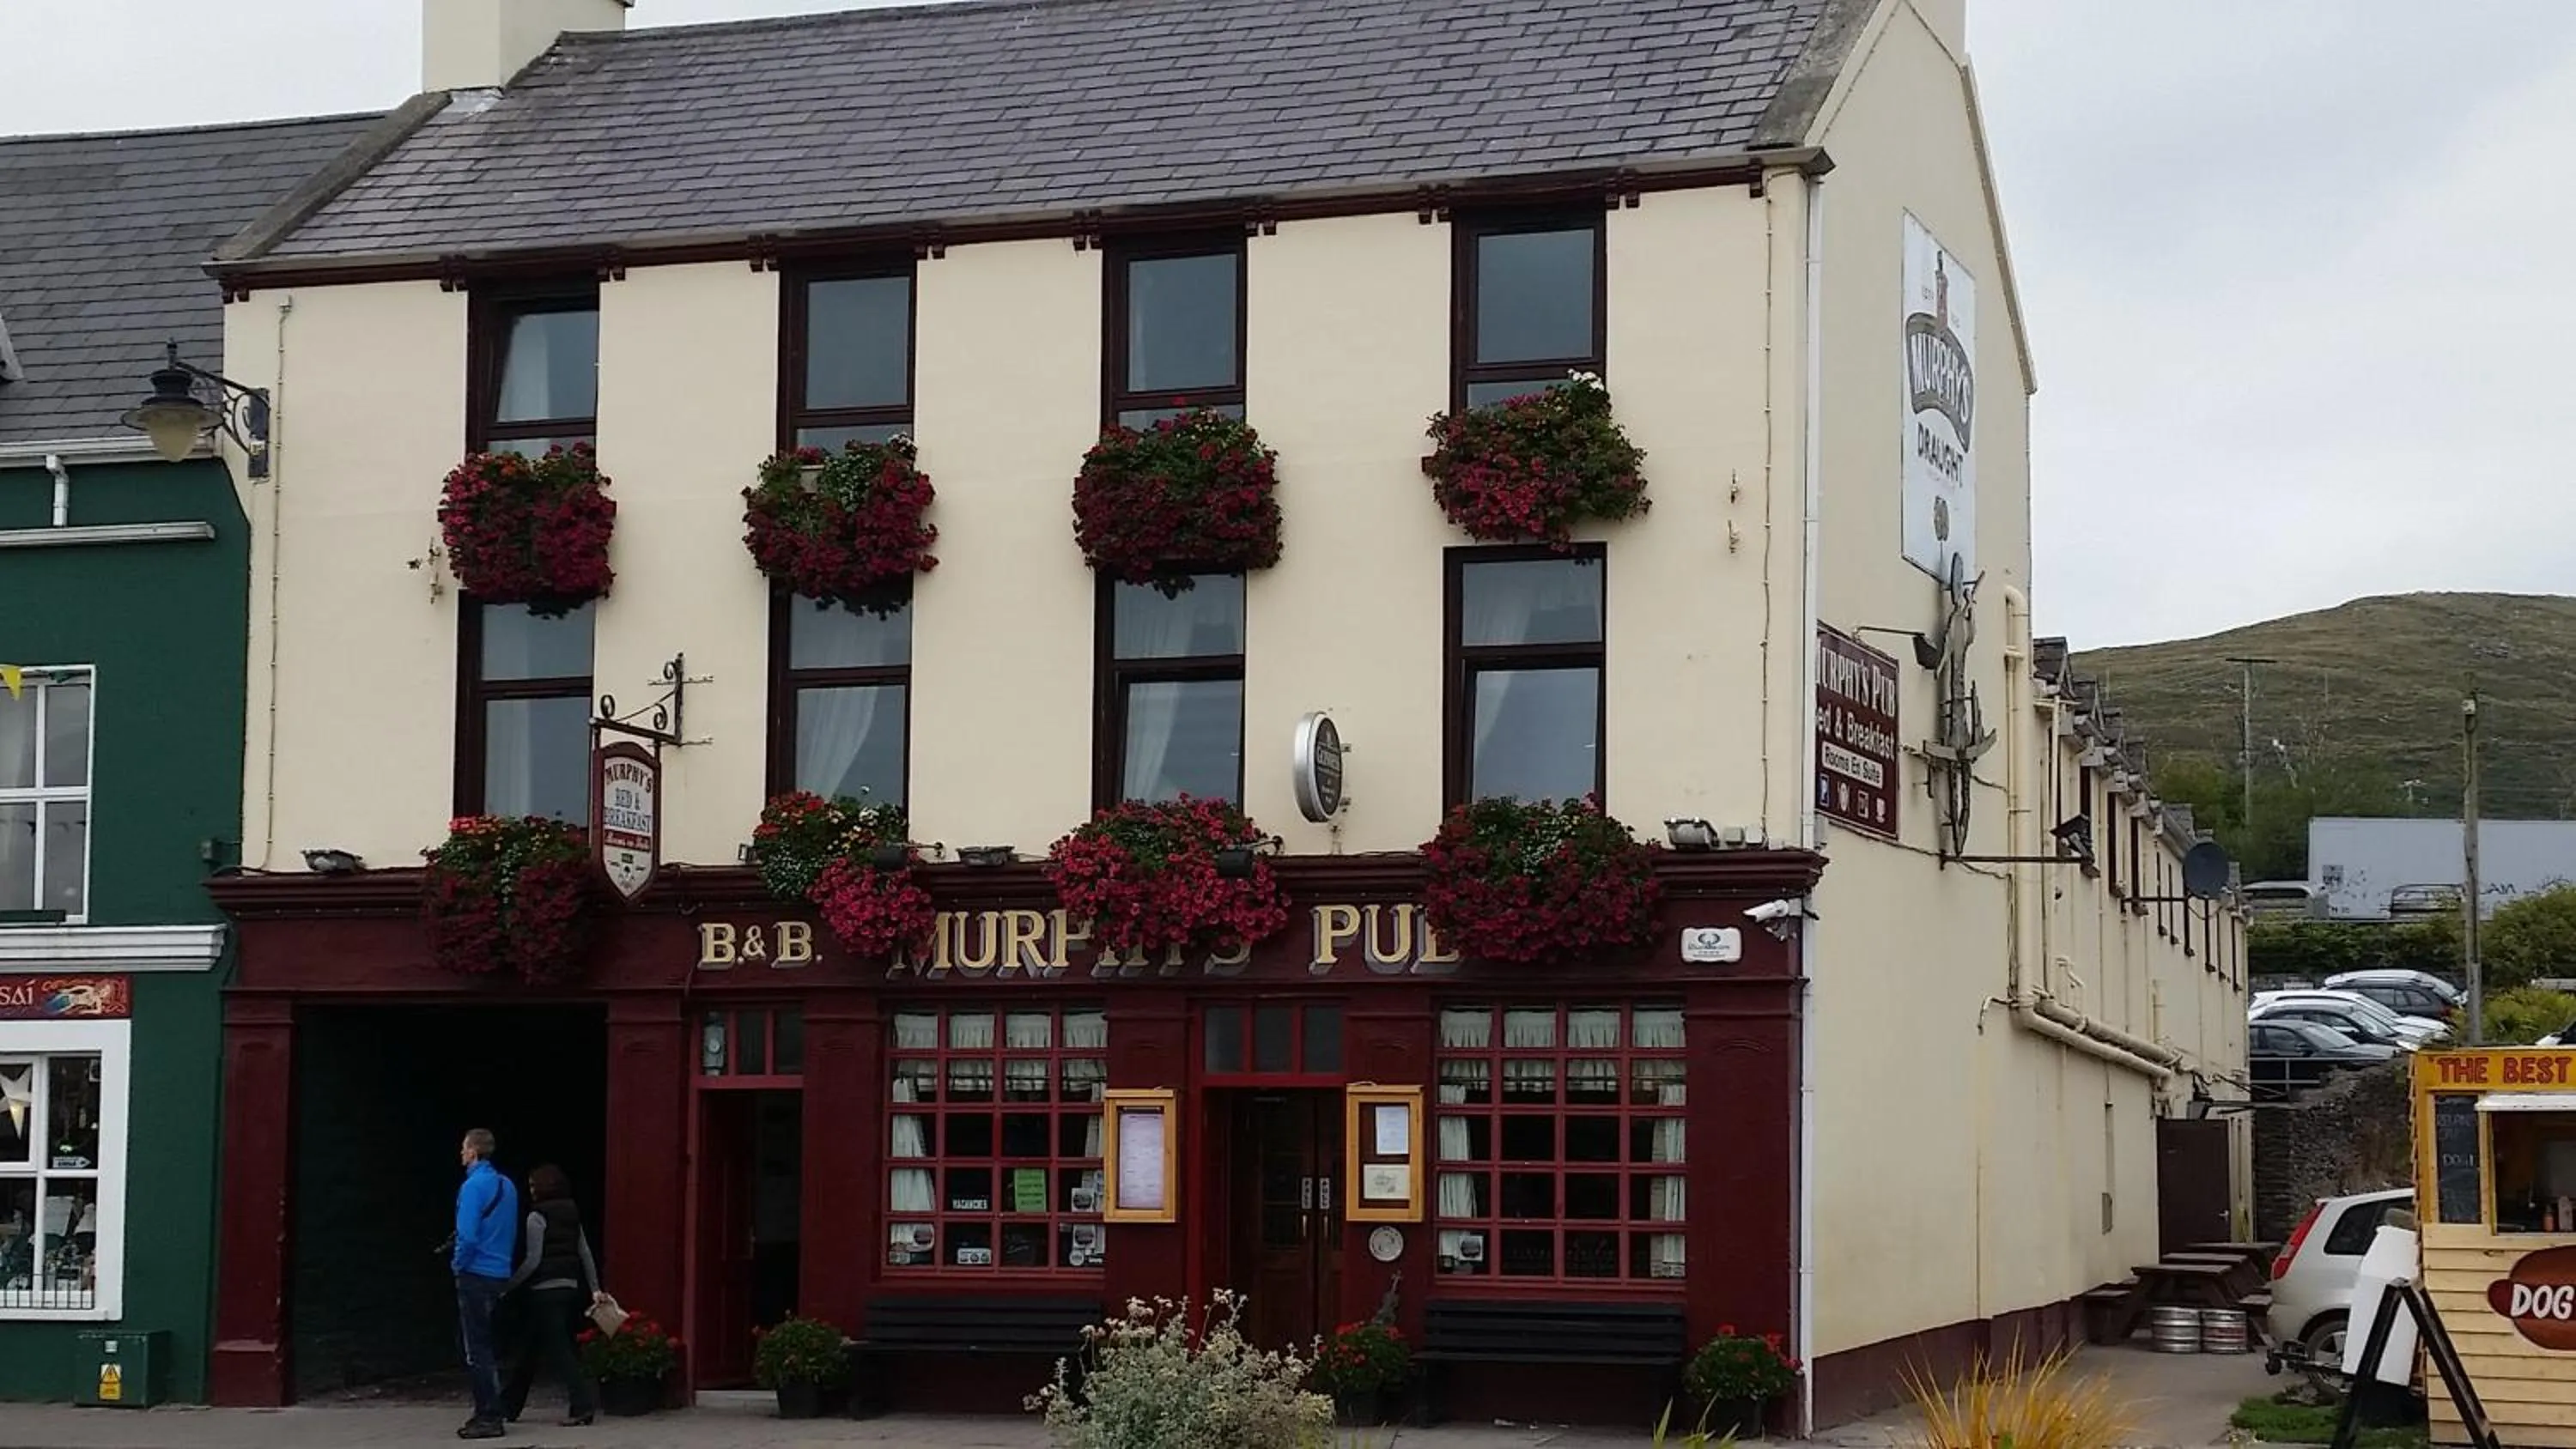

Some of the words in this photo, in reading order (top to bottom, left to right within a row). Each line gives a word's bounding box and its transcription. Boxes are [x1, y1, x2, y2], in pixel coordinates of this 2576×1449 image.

[1917, 421, 1965, 488] DRAUGHT
[1871, 664, 1896, 718] PUB
[1816, 702, 1832, 735] ed
[1835, 706, 1843, 740] &
[1847, 712, 1895, 761] Breakfast
[2503, 1056, 2573, 1084] BEST
[2510, 1283, 2575, 1319] DOG
